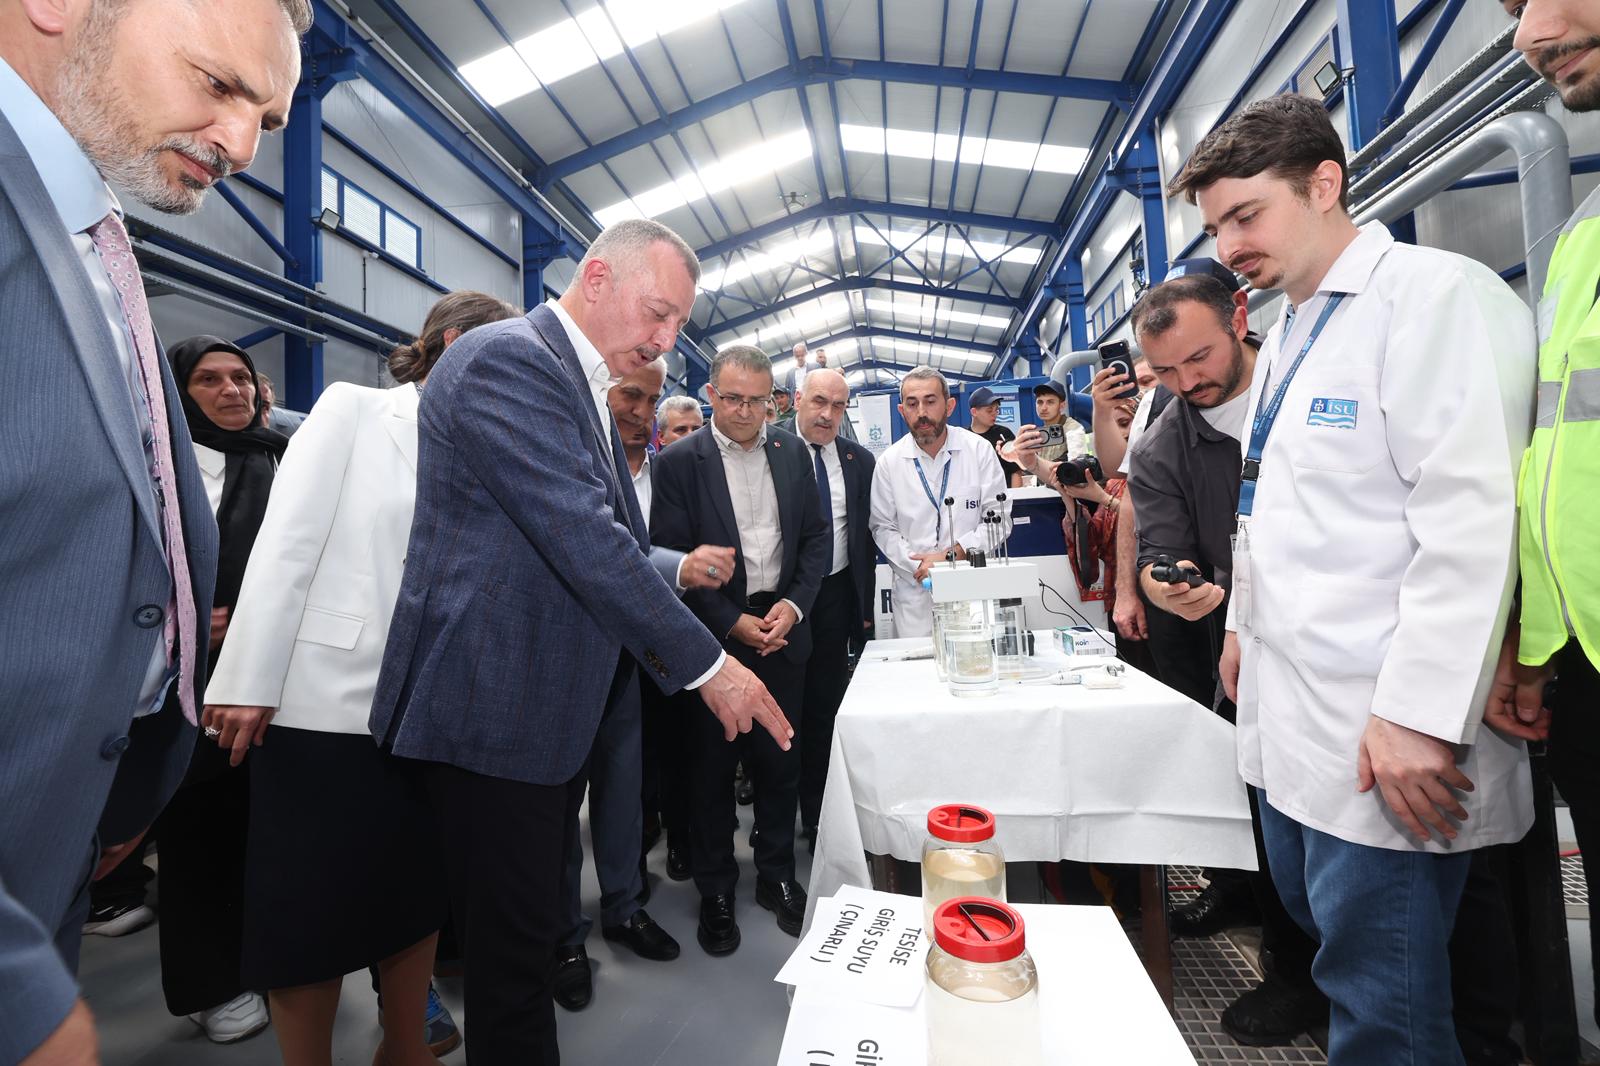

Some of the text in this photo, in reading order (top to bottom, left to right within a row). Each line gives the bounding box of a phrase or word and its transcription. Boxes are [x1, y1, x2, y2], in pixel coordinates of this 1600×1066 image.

[846, 908, 896, 974] GİRİŞ SUYU
[889, 928, 922, 966] TESİSE
